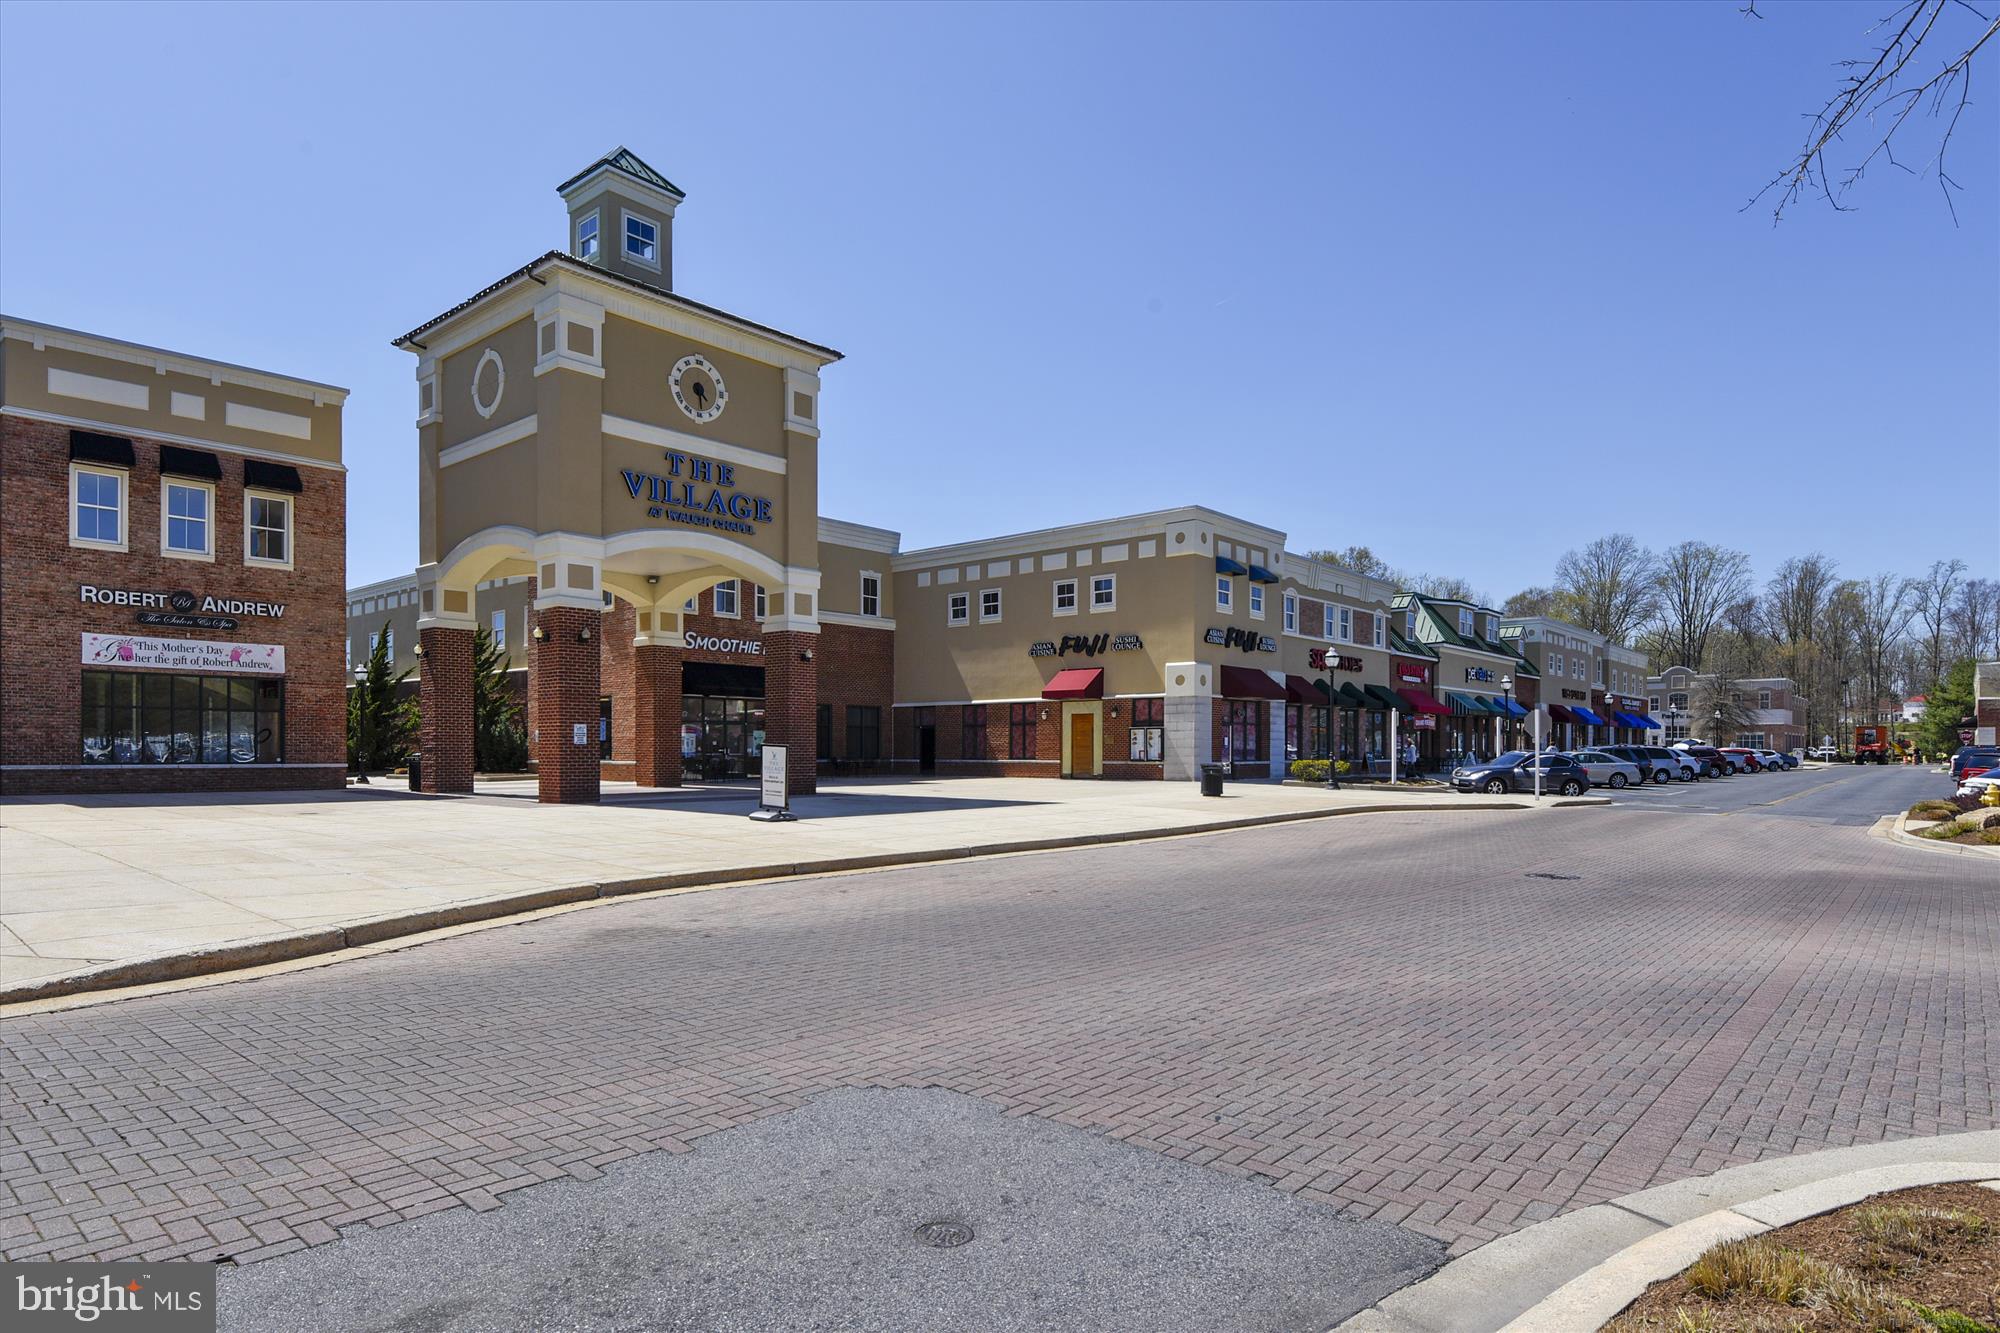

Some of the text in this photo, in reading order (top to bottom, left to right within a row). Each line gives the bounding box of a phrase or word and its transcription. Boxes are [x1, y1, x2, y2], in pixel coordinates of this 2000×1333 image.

[666, 452, 736, 487] THE
[622, 470, 773, 522] VILLAGE
[648, 506, 663, 519] AT
[80, 585, 168, 608] ROBERT
[201, 596, 285, 618] ANDREW
[163, 616, 193, 625] Salon
[212, 619, 233, 630] Spa
[136, 641, 224, 657] This Mother's Day
[685, 631, 762, 654] SMOOTHIE
[1058, 633, 1109, 657] FUJI
[1111, 642, 1141, 652] LOUNGE
[1115, 636, 1137, 644] SUSHI
[1225, 627, 1258, 653] FUJI
[135, 653, 152, 663] her
[154, 655, 170, 664] the
[172, 655, 187, 667] gift
[189, 656, 200, 666] of
[202, 657, 233, 667] Robert
